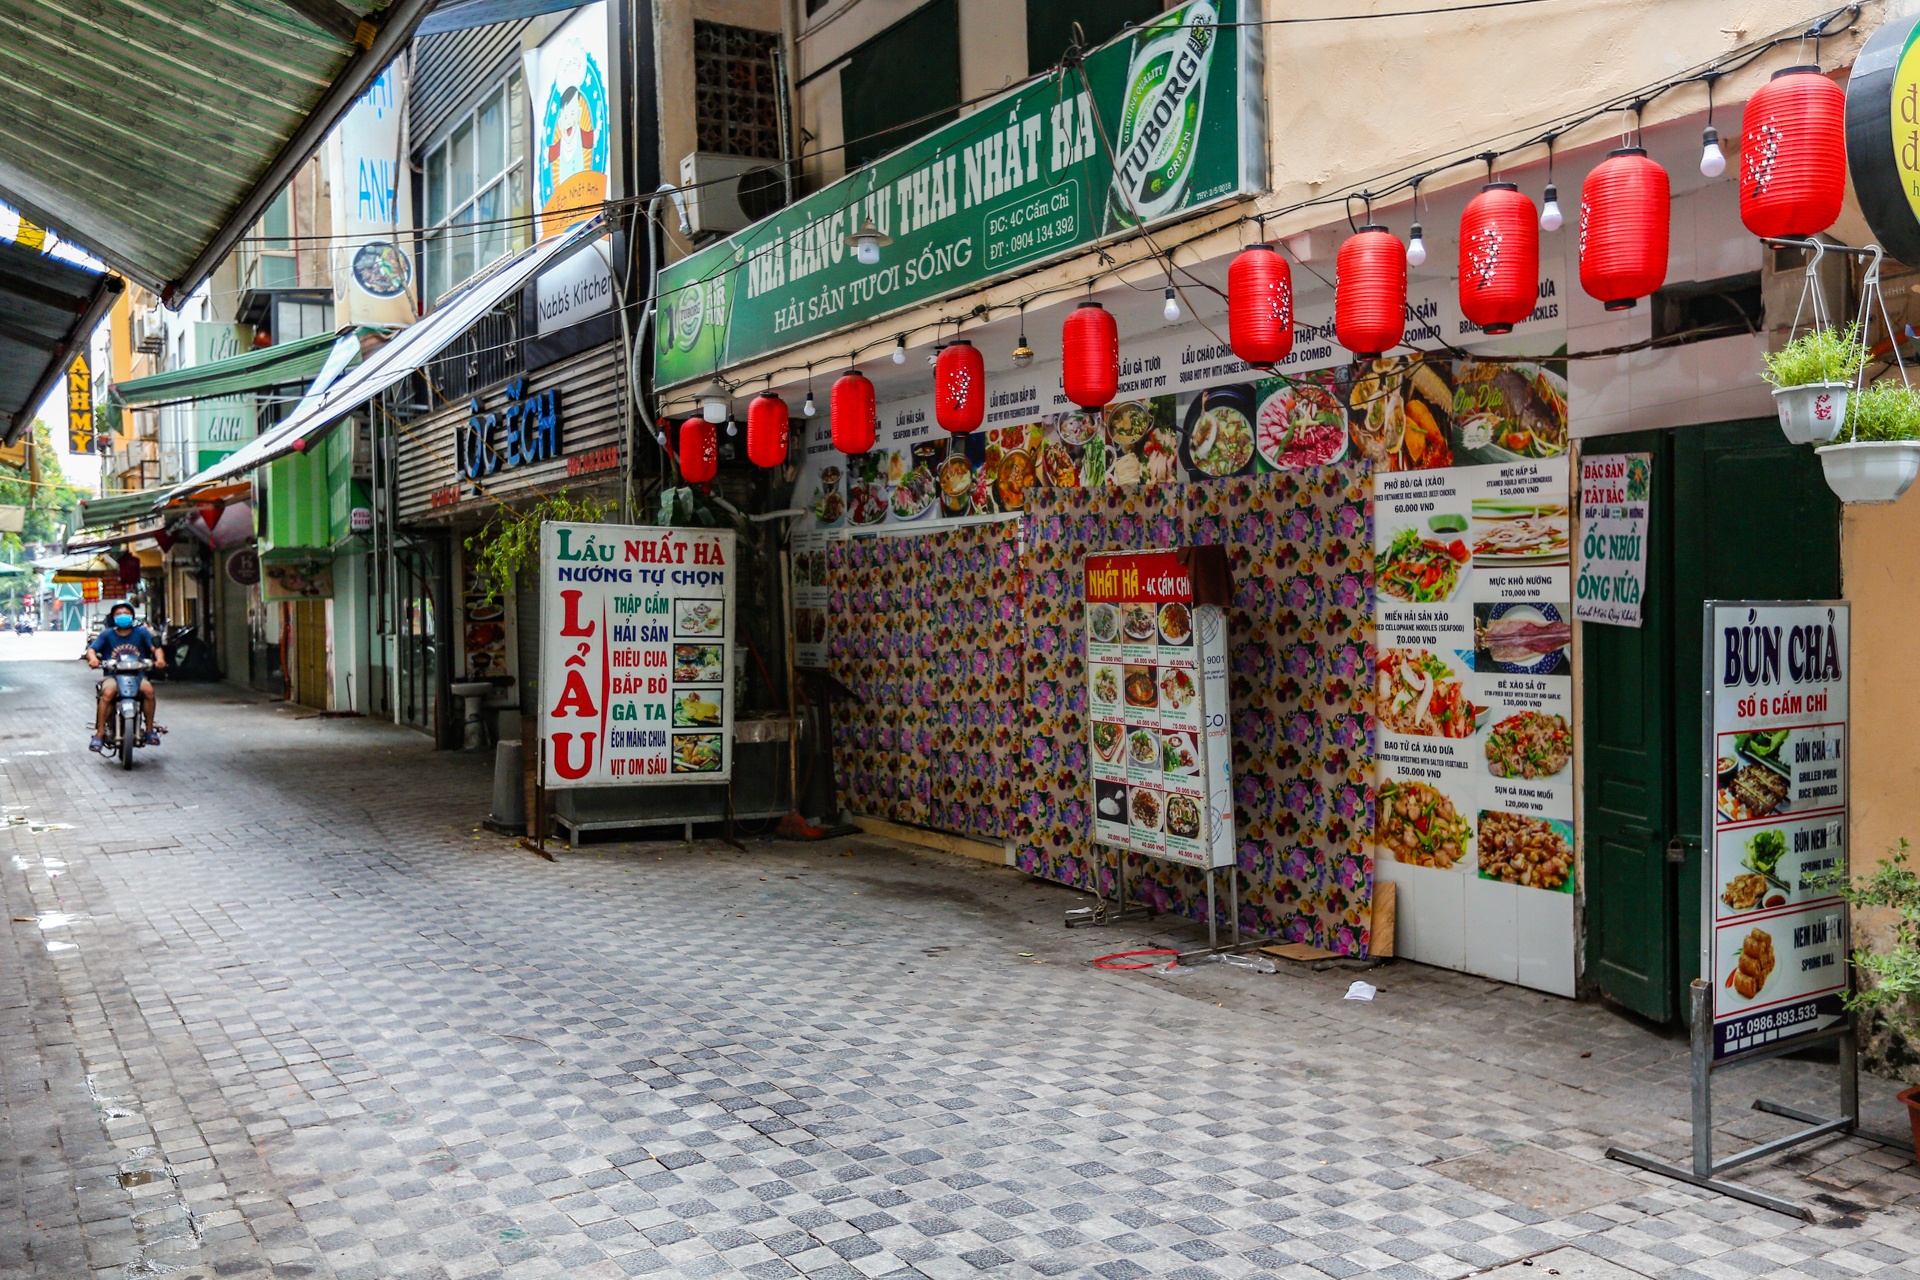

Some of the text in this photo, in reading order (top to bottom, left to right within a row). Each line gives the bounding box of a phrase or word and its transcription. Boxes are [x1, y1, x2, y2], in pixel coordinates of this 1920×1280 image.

[1124, 94, 1138, 143] GENUINE
[1136, 65, 1164, 95] QUALITY
[1119, 51, 1198, 194] TUBORG
[1166, 131, 1192, 180] GREEN
[747, 227, 786, 299] NHÀ
[789, 211, 845, 280] HÀNG
[897, 147, 957, 236] THÁI
[963, 98, 1042, 210] NHẤT
[989, 188, 1070, 236] ĐC: 4C Cấm Chỉ
[1010, 230, 1034, 254] 0904
[1036, 223, 1054, 247] 134
[1056, 216, 1074, 239] 392
[774, 236, 973, 334] HẢI SẢN TƯƠI SỐNG
[538, 269, 613, 324] Nabb's Kitchen
[1294, 327, 1318, 345] THẬP
[1404, 325, 1441, 342] COMBO
[1182, 344, 1215, 365] LẨU CHÁO
[1300, 346, 1332, 362] COMBO
[1133, 357, 1143, 375] GÀ
[1203, 367, 1211, 379] POT
[1029, 385, 1037, 400] BÒ
[1140, 375, 1167, 390] HOT POT
[208, 417, 242, 442] ANH
[893, 425, 929, 440] SEAFOOD HOT POT
[1425, 475, 1445, 487] (XÀO)
[1500, 464, 1538, 478] MỰC HẤP SẢ
[1584, 461, 1604, 482] ĐẶC
[1500, 486, 1540, 496] 150,000 VND
[1584, 484, 1604, 504] TÂY
[1394, 502, 1435, 513] 60.000 VND
[556, 529, 726, 566] LẨU NHẤT HÀ
[1583, 521, 1641, 561] ỐC NHỒI
[558, 565, 724, 588] NƯỚNG TỰ CHỌN
[1088, 559, 1119, 599] NHẤT
[1122, 561, 1139, 599] HÀ
[1157, 570, 1175, 598] CẤM
[1489, 574, 1552, 587] MỰC KHÔ NƯỚNG
[1576, 563, 1640, 605] ỐNG NỨA
[614, 590, 669, 618] THẬP CẨM
[1501, 589, 1540, 598] 170,000 VND
[1384, 609, 1449, 621] MIẾN HẢI SẢN XÀO
[613, 618, 669, 643] HẢI SẢN
[1385, 623, 1414, 632] CELLOPHANE
[1416, 624, 1437, 632] NOODLES
[613, 647, 668, 668] RIÊU CUA
[1723, 607, 1843, 688] BÚN CHẢ
[550, 589, 599, 780] LẨU
[612, 672, 668, 695] BẮP BÒ
[1497, 679, 1507, 689] BÊ
[1509, 680, 1524, 689] XÀO
[1525, 680, 1534, 690] SẢ
[612, 700, 667, 721] GÀ TA
[1503, 698, 1528, 707] 130,000
[1737, 688, 1828, 718] SỐ 6 CẤM CHỈ
[611, 724, 667, 748] ẾCH MĂNG CHUA
[1384, 741, 1398, 750] BAO
[1411, 741, 1420, 752] CÁ
[1422, 742, 1437, 753] XÀO
[1439, 745, 1454, 755] DƯA
[1795, 732, 1826, 763] BÚN CHẢ
[611, 753, 668, 780] VỊT OM SẤU
[1397, 766, 1442, 779] 150.000 VND
[1799, 768, 1838, 783] GRILLED PORK
[1494, 785, 1553, 799] SỤN GÀ RANG MUỐI
[1799, 784, 1838, 800] RICE NOODLES
[1530, 803, 1543, 811] VND
[1794, 828, 1827, 853] BÚN NEM
[1800, 860, 1821, 873] SPRING
[1794, 918, 1827, 949] NEM RÁN
[1801, 952, 1835, 972] SPRING ROLL
[1725, 1003, 1817, 1041] ĐT: 0986.893.533
